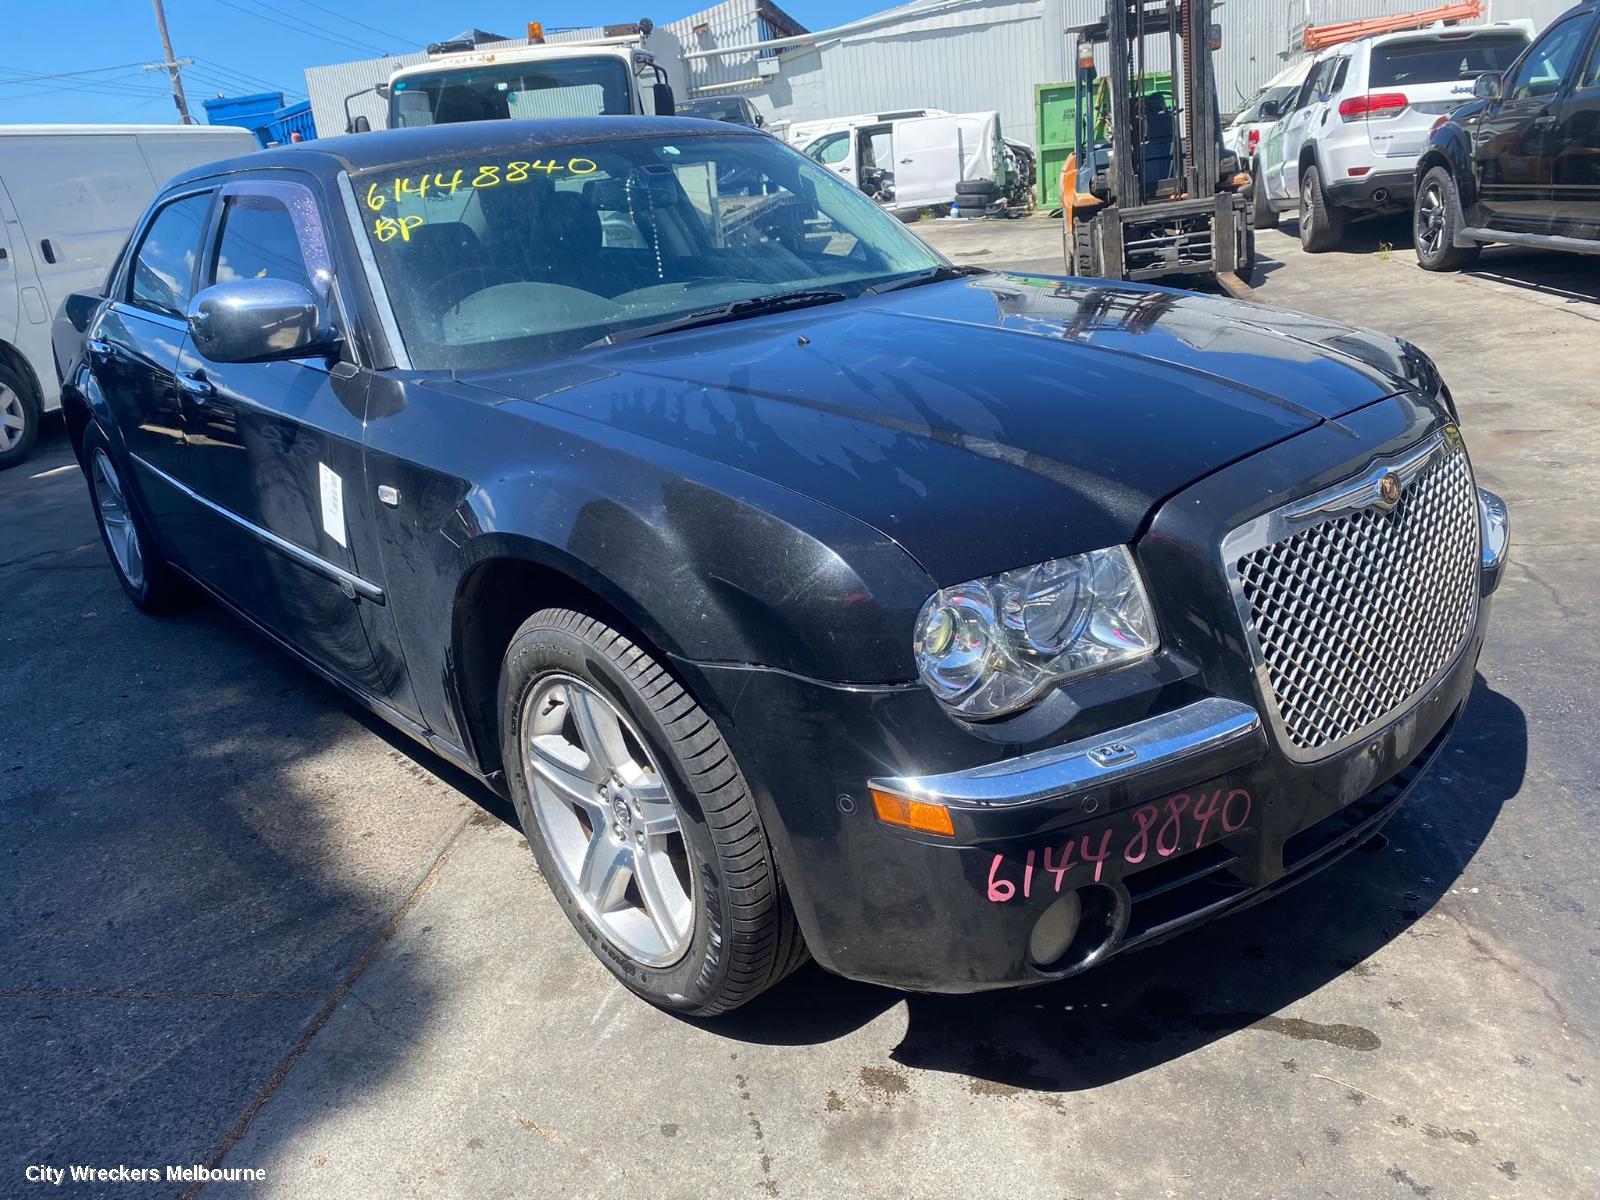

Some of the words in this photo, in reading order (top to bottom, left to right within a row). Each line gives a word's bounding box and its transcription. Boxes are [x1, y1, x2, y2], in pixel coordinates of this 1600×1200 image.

[367, 158, 597, 211] 61448840
[374, 215, 423, 242] BP
[987, 788, 1252, 903] 61448840
